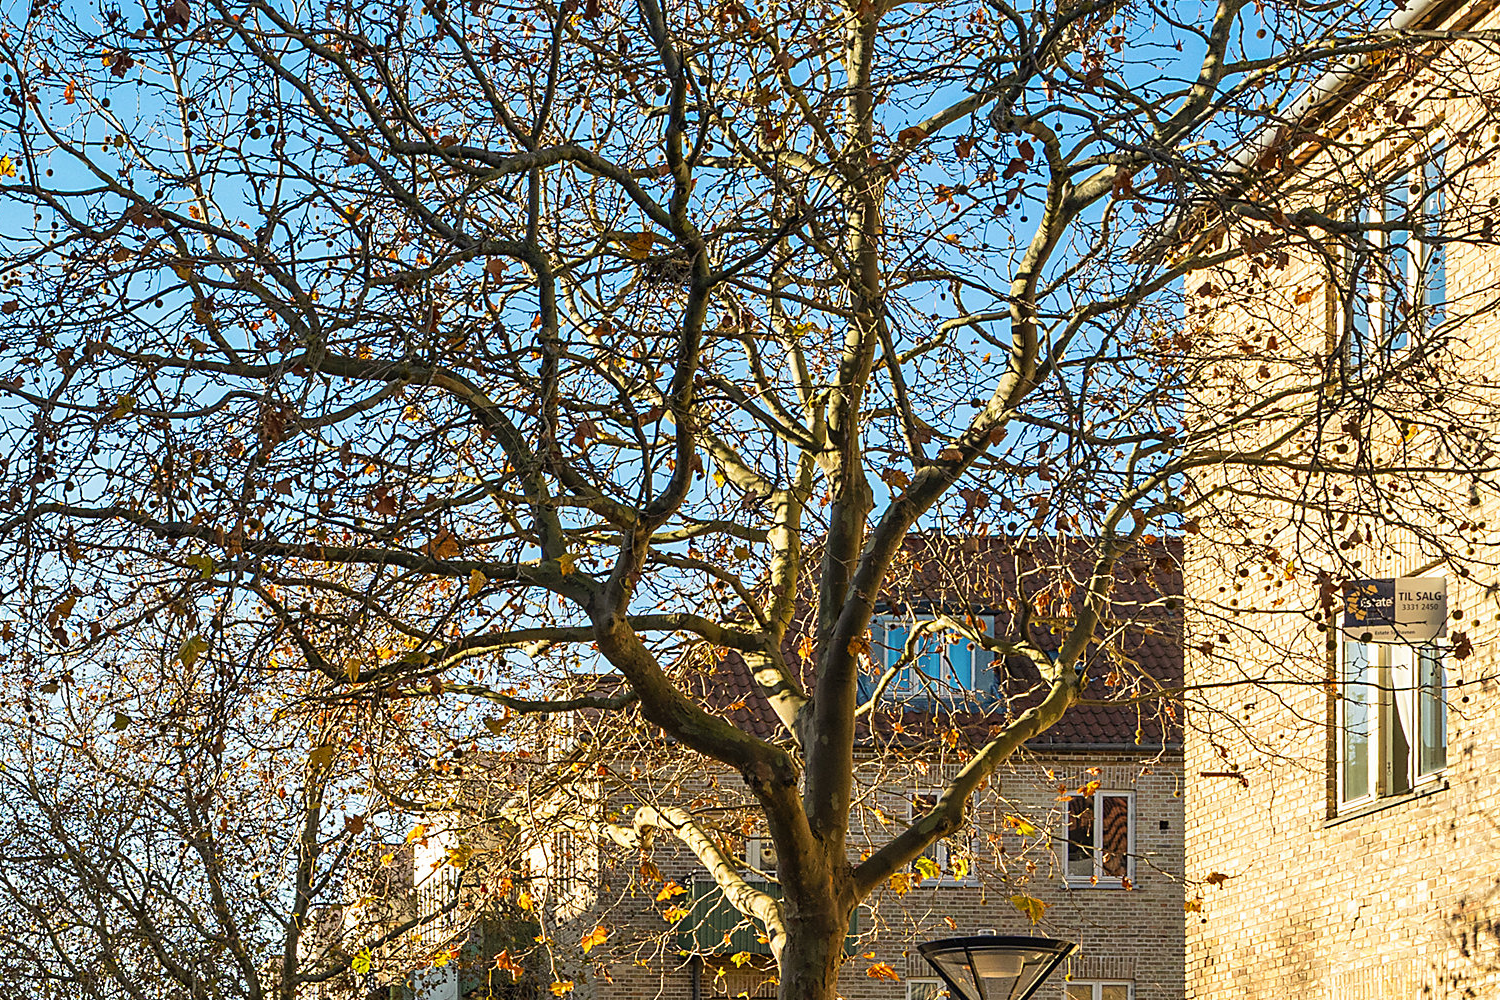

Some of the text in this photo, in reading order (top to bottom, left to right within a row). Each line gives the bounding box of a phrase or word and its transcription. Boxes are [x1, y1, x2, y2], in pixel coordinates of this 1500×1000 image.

[1399, 591, 1442, 601] TIL SALG
[1360, 597, 1393, 608] Estate
